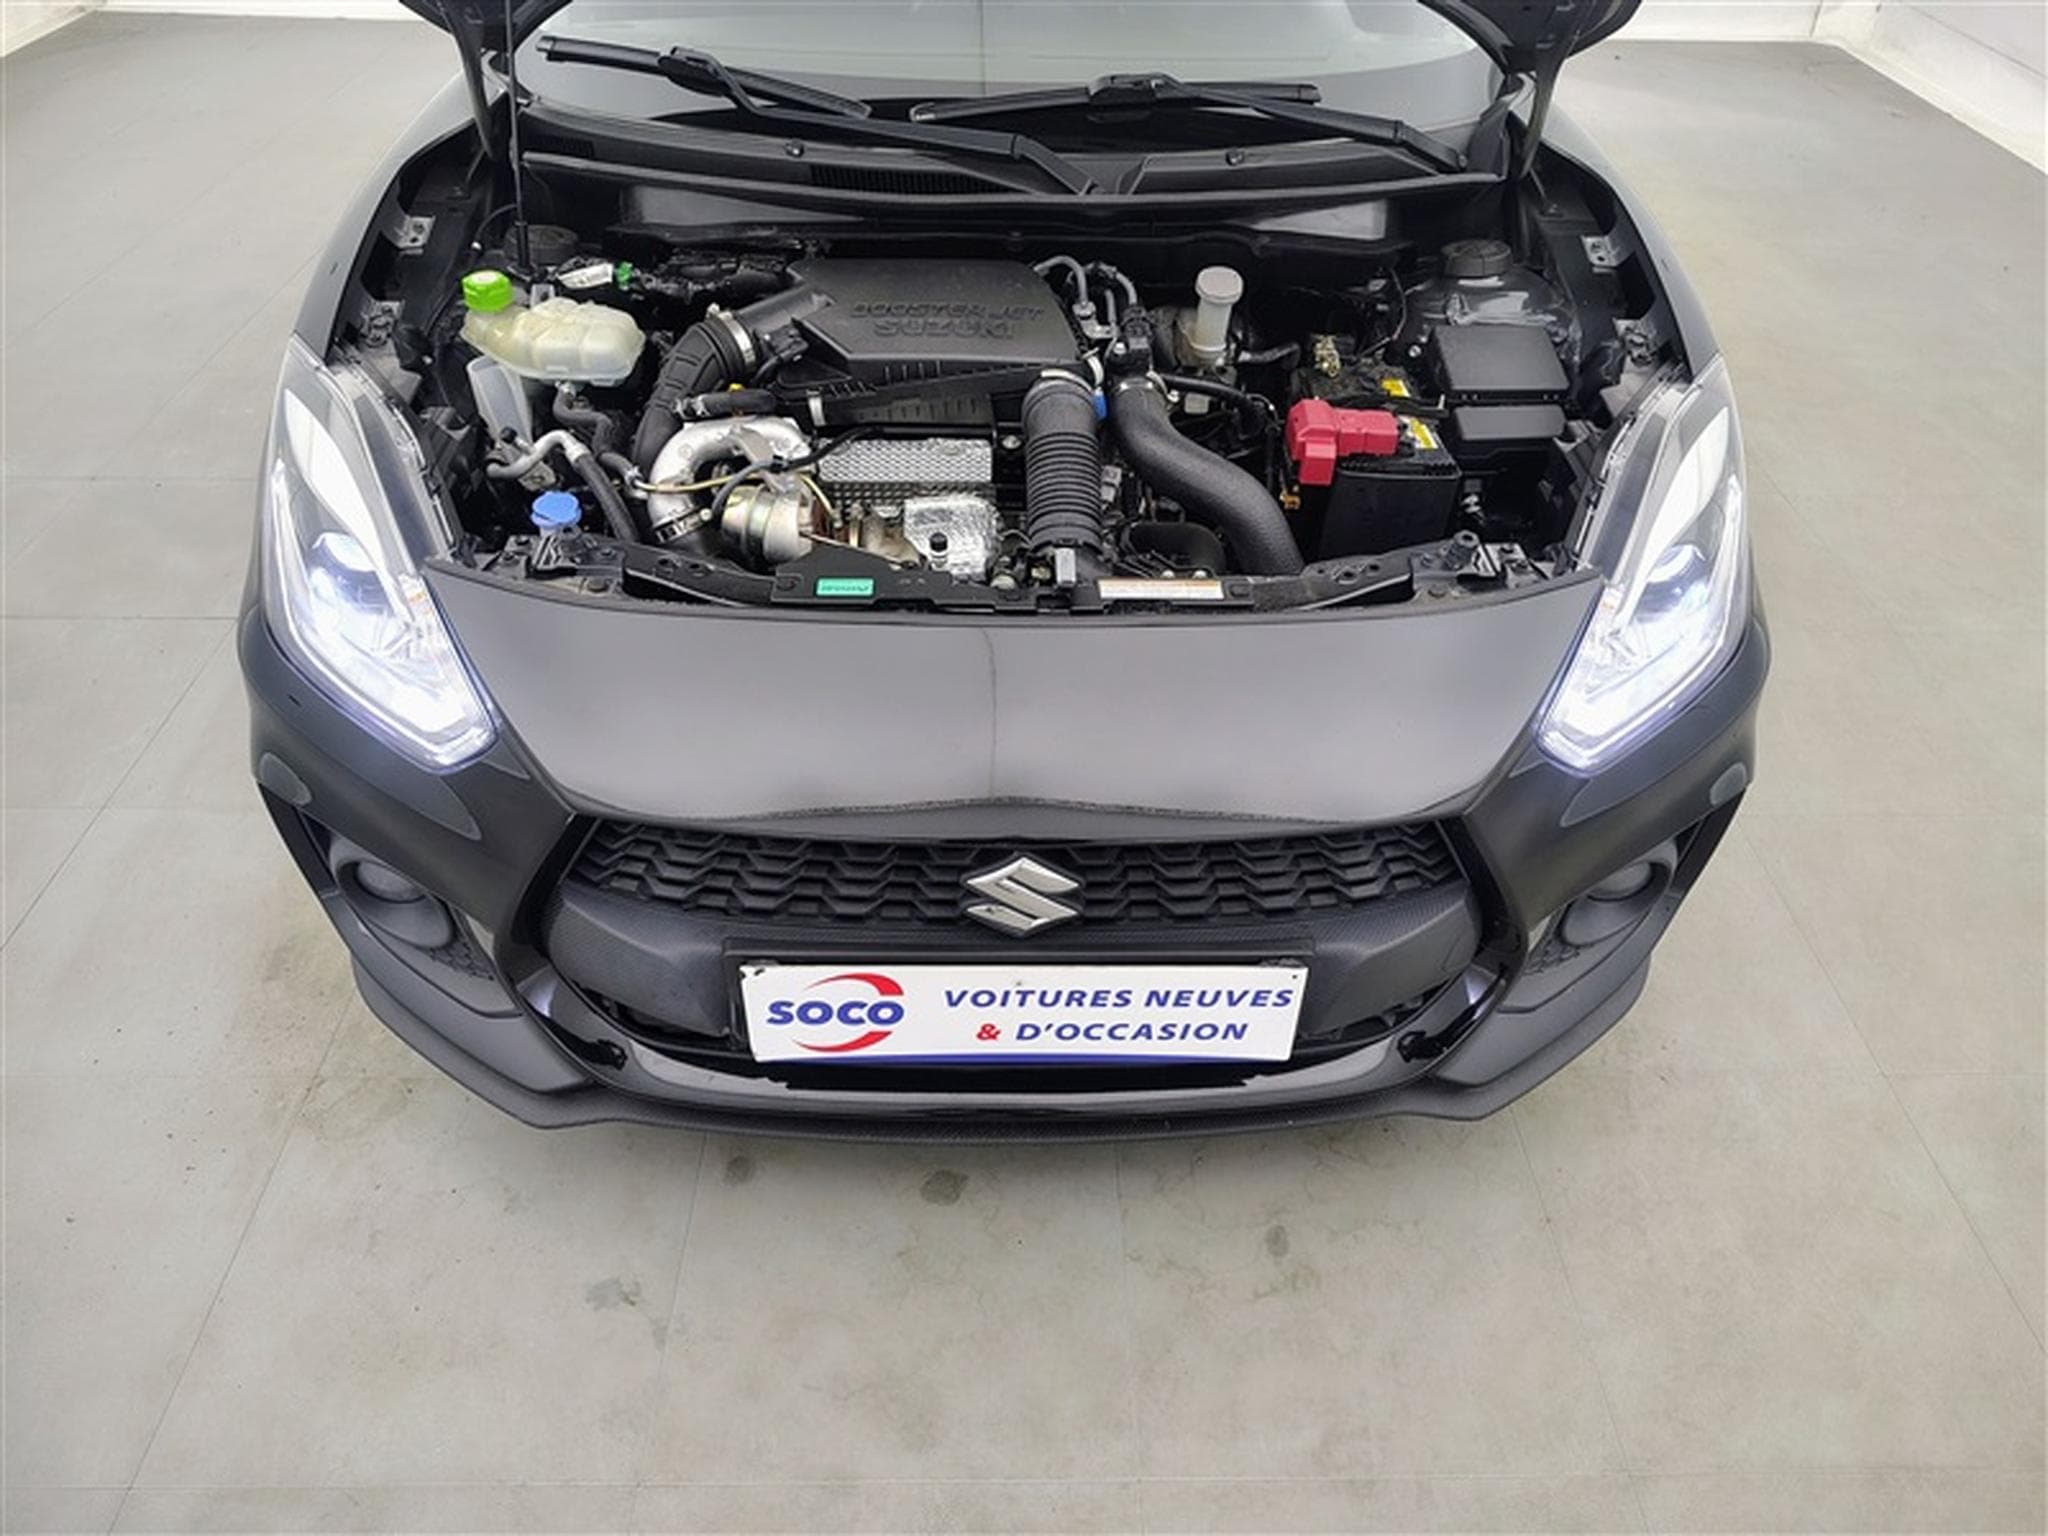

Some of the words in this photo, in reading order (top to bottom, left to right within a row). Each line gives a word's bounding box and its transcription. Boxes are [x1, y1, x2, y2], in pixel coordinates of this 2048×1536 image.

[945, 989, 1133, 1009] VOITURES
[1144, 989, 1293, 1009] NEUVES
[768, 1000, 906, 1026] SOCO
[976, 1022, 1000, 1042] &
